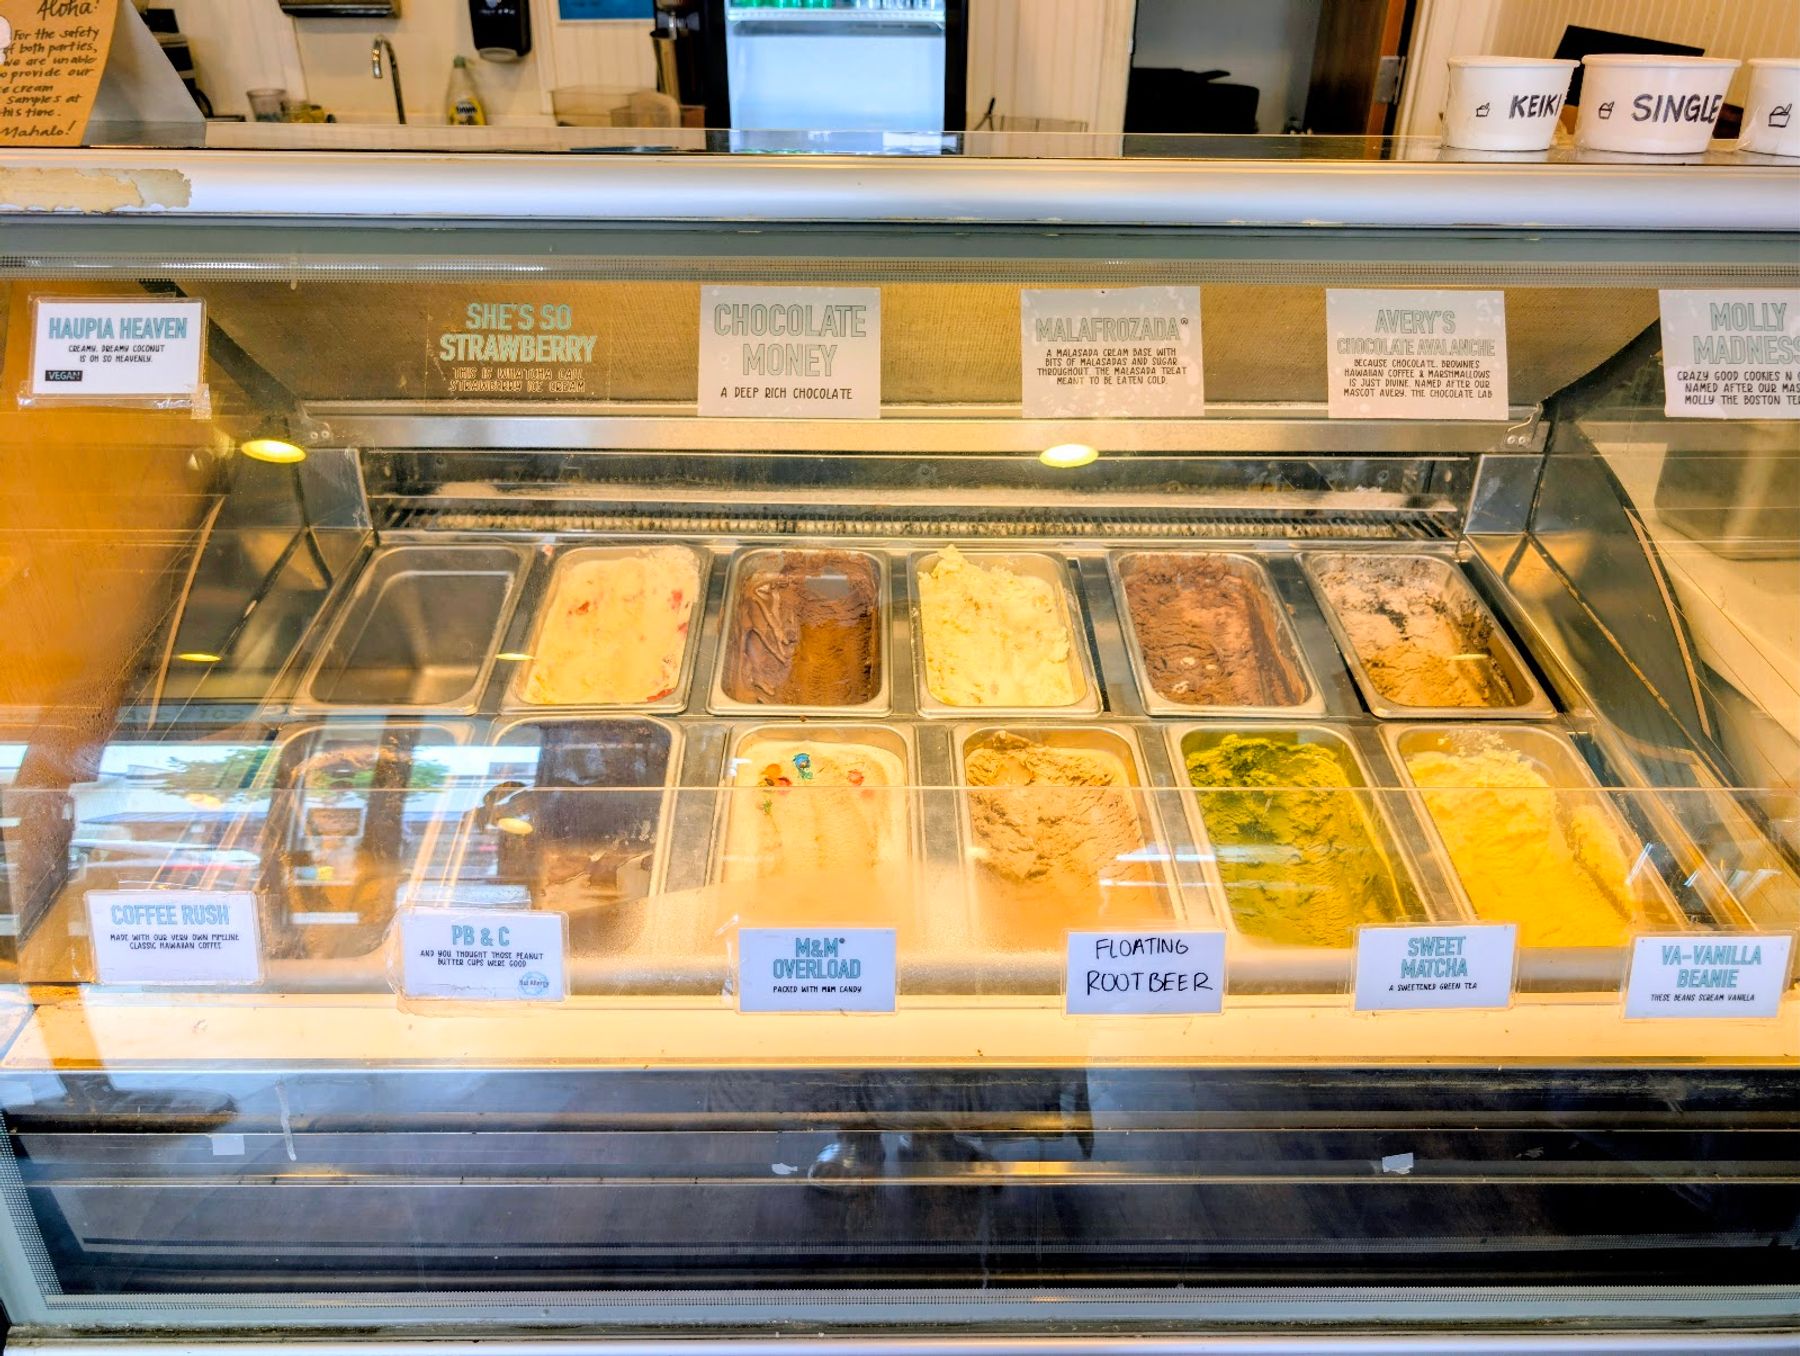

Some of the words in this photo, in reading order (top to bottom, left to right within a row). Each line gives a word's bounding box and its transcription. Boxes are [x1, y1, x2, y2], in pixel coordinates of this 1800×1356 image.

[13, 29, 32, 41] For
[34, 28, 56, 40] the
[59, 26, 100, 42] safety
[19, 43, 45, 55] both
[47, 41, 98, 58] parties,
[3, 58, 21, 67] we
[26, 58, 46, 67] are
[53, 56, 98, 66] unable
[10, 67, 61, 84] provide
[67, 68, 95, 77] our
[12, 85, 54, 94] cream
[65, 93, 82, 104] at
[1508, 93, 1562, 120] KEIKI
[1631, 92, 1724, 125] SINGLE
[1, 120, 77, 138] Mahalo!
[465, 302, 535, 332] SHE'S
[540, 303, 573, 331] SO
[714, 303, 867, 338] CHOCOLATE
[1375, 309, 1456, 334] AVERY'S
[1709, 303, 1787, 332] MOLLY
[48, 317, 115, 340] HAUPIA
[119, 317, 188, 340] HEAVEN
[101, 344, 129, 353] DREAMY
[132, 344, 166, 353] COCONUT
[439, 333, 598, 364] STRAWBERRY
[1046, 348, 1052, 357] A
[1056, 347, 1099, 357] MALASADA
[1103, 348, 1129, 357] CREAM
[1133, 347, 1152, 357] BASE
[1156, 347, 1176, 357] WITH
[1337, 337, 1415, 356] CHOCOLATE
[1417, 338, 1496, 356] AVALANCHE
[79, 354, 87, 363] IS
[90, 354, 99, 363] OH
[102, 354, 112, 363] SO
[742, 343, 838, 377] MONEY
[1045, 357, 1062, 367] BITS
[1066, 357, 1076, 366] OF
[1080, 357, 1127, 366] MALASADAS
[1131, 357, 1148, 366] AND
[1152, 357, 1178, 366] SUGAR
[1353, 358, 1388, 368] BECAUSE
[1441, 360, 1480, 369] BROWNIES
[47, 371, 81, 381] VEGAN
[452, 367, 477, 380] THIS
[481, 367, 493, 380] IS
[558, 367, 586, 381] CALL
[1095, 366, 1110, 375] THE
[1114, 366, 1156, 375] MALASADA
[1161, 366, 1187, 375] TREAT
[1344, 368, 1384, 377] HAWAIIAN
[1388, 369, 1415, 378] COFFEE
[1419, 369, 1425, 378] &
[1428, 370, 1490, 379] MARSHMALLOWS
[1677, 371, 1709, 382] CRAZY
[1714, 371, 1739, 381] GOOD
[1744, 371, 1781, 381] COOKIES
[1785, 371, 1793, 381] N
[448, 380, 523, 393] STRAWBERRY
[526, 380, 544, 393] ICE
[548, 380, 586, 393] CREAM
[1056, 376, 1085, 385] MEANT
[1089, 376, 1099, 385] TO
[1103, 376, 1112, 385] BE
[1116, 376, 1143, 385] EATEN
[1349, 378, 1356, 387] IS
[1361, 378, 1381, 387] JUST
[1414, 379, 1442, 388] NAMED
[1446, 380, 1471, 389] AFTER
[1475, 379, 1490, 389] OUR
[720, 386, 727, 399] A
[734, 387, 759, 399] DEEP
[765, 387, 787, 399] RICH
[793, 388, 853, 400] CHOCOLATE
[1343, 388, 1375, 398] MASCOT
[1411, 389, 1426, 398] THE
[1430, 389, 1474, 399] CHOCOLATE
[1478, 389, 1493, 399] LAB
[1685, 383, 1718, 393] NAMED
[1723, 383, 1753, 393] AFTER
[1758, 383, 1777, 393] OUR
[1685, 395, 1715, 405] MOLLY
[1720, 395, 1738, 405] THE
[1744, 395, 1781, 405] BOSTON
[110, 904, 177, 926] COFFEE
[181, 904, 230, 926] RUSH
[110, 934, 128, 942] MADE
[132, 934, 150, 942] WITH
[154, 934, 167, 942] OUR
[171, 934, 188, 942] VERY
[192, 934, 208, 942] OWN
[451, 925, 476, 946] PB
[480, 927, 494, 947] &
[499, 926, 510, 947] C
[129, 942, 156, 950] CLASSIC
[160, 942, 195, 950] HAWAIIAN
[1096, 937, 1190, 960] FLOATING
[1407, 936, 1467, 957] SWEET
[420, 950, 434, 958] AND
[438, 950, 452, 958] YOU
[456, 951, 487, 959] THOUGHT
[492, 951, 512, 959] THOSE
[516, 952, 544, 960] PEANUT
[1661, 945, 1762, 966] VA-VANILLA
[467, 959, 484, 967] CUPS
[509, 960, 527, 968] GOOD
[773, 959, 862, 980] OVERLOAD
[1400, 957, 1469, 979] MATCHA
[1676, 968, 1740, 989] BEANIE
[773, 985, 798, 993] PACKED
[801, 985, 818, 993] WITH
[821, 985, 837, 993] M&M
[840, 985, 862, 993] CANDY
[1389, 984, 1394, 992] A
[1397, 983, 1437, 992] SWEETENED
[1440, 982, 1461, 991] GREEN
[1464, 982, 1478, 990] TEA
[1651, 993, 1671, 1002] THESE
[1673, 993, 1696, 1002] BEANS
[1698, 993, 1725, 1002] SCREAM
[1728, 993, 1756, 1002] VANILLA
